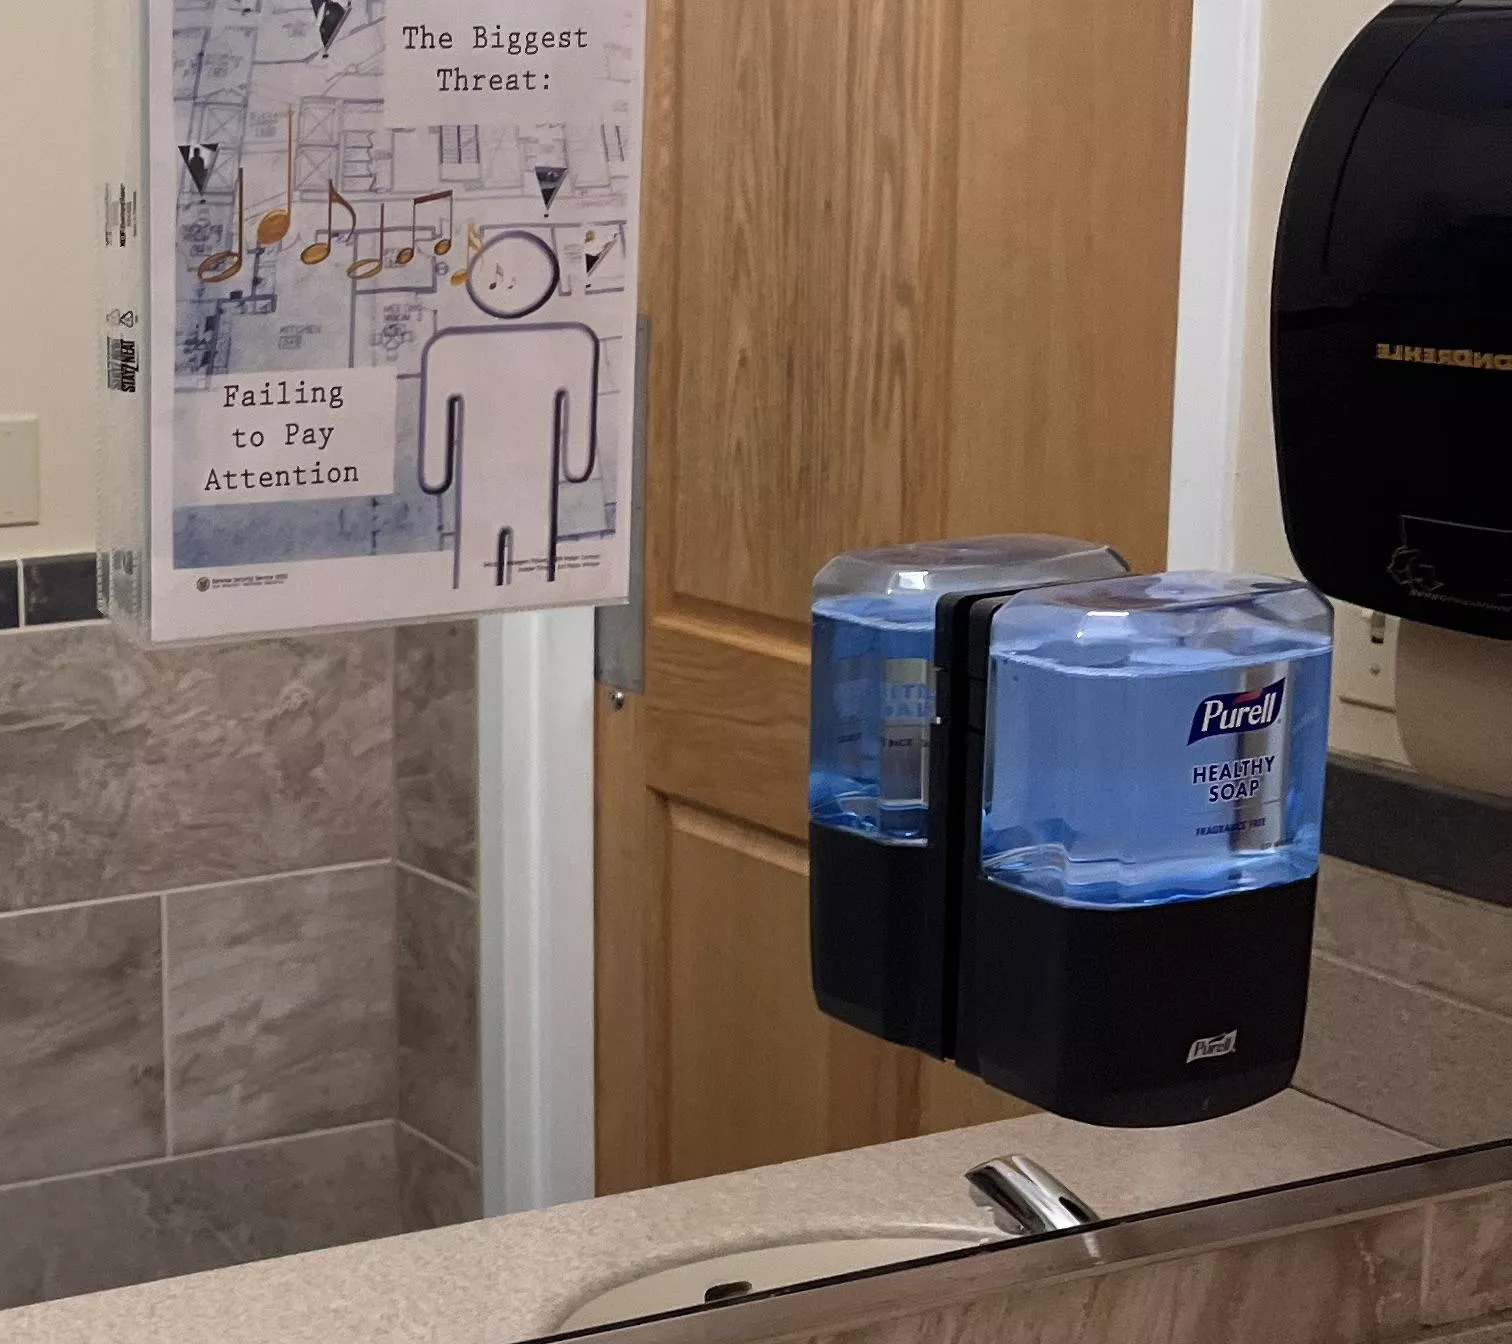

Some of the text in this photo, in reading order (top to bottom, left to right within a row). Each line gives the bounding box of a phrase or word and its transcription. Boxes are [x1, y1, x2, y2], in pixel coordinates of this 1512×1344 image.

[402, 24, 588, 55] The Biggest
[437, 67, 550, 91] Threat:
[223, 380, 344, 409] Failing
[232, 423, 335, 450] to Pay
[204, 461, 359, 491] Attention
[1201, 692, 1277, 732] Purell
[1192, 755, 1276, 784] HEALTHY
[1208, 779, 1260, 802] SOAP
